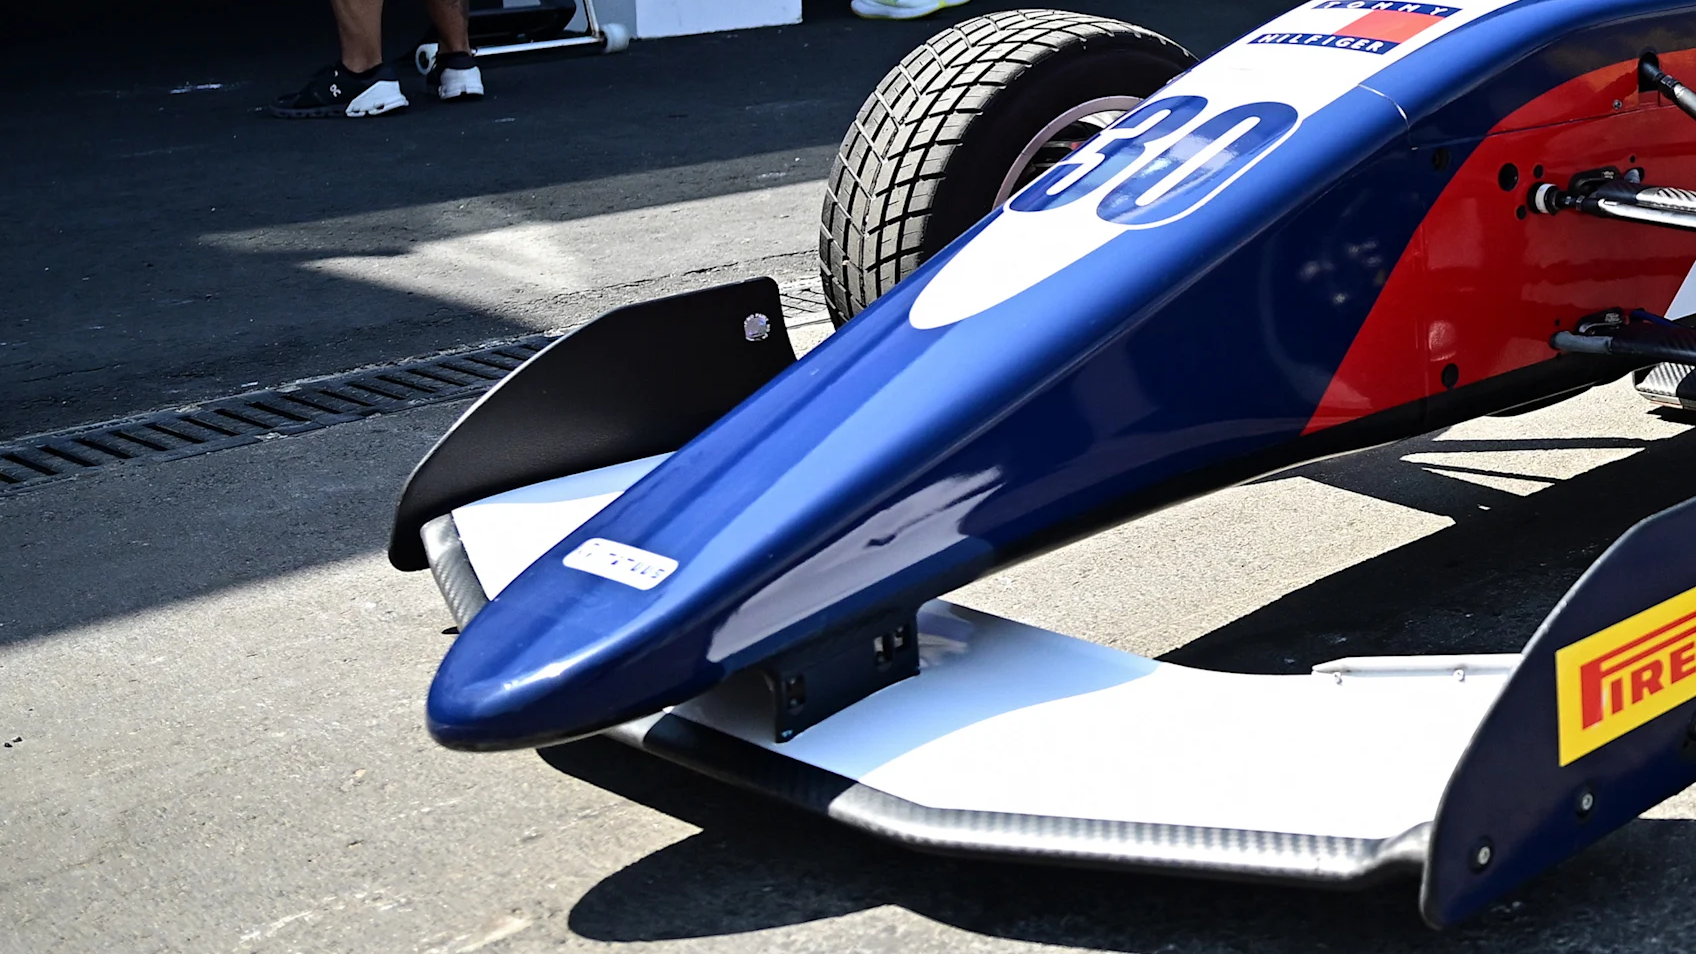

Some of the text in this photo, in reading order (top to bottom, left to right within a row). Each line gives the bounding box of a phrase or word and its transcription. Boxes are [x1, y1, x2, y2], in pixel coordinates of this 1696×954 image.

[1324, 0, 1449, 16] TOMMY
[1257, 34, 1385, 53] HILFIGER
[1008, 94, 1300, 226] 30
